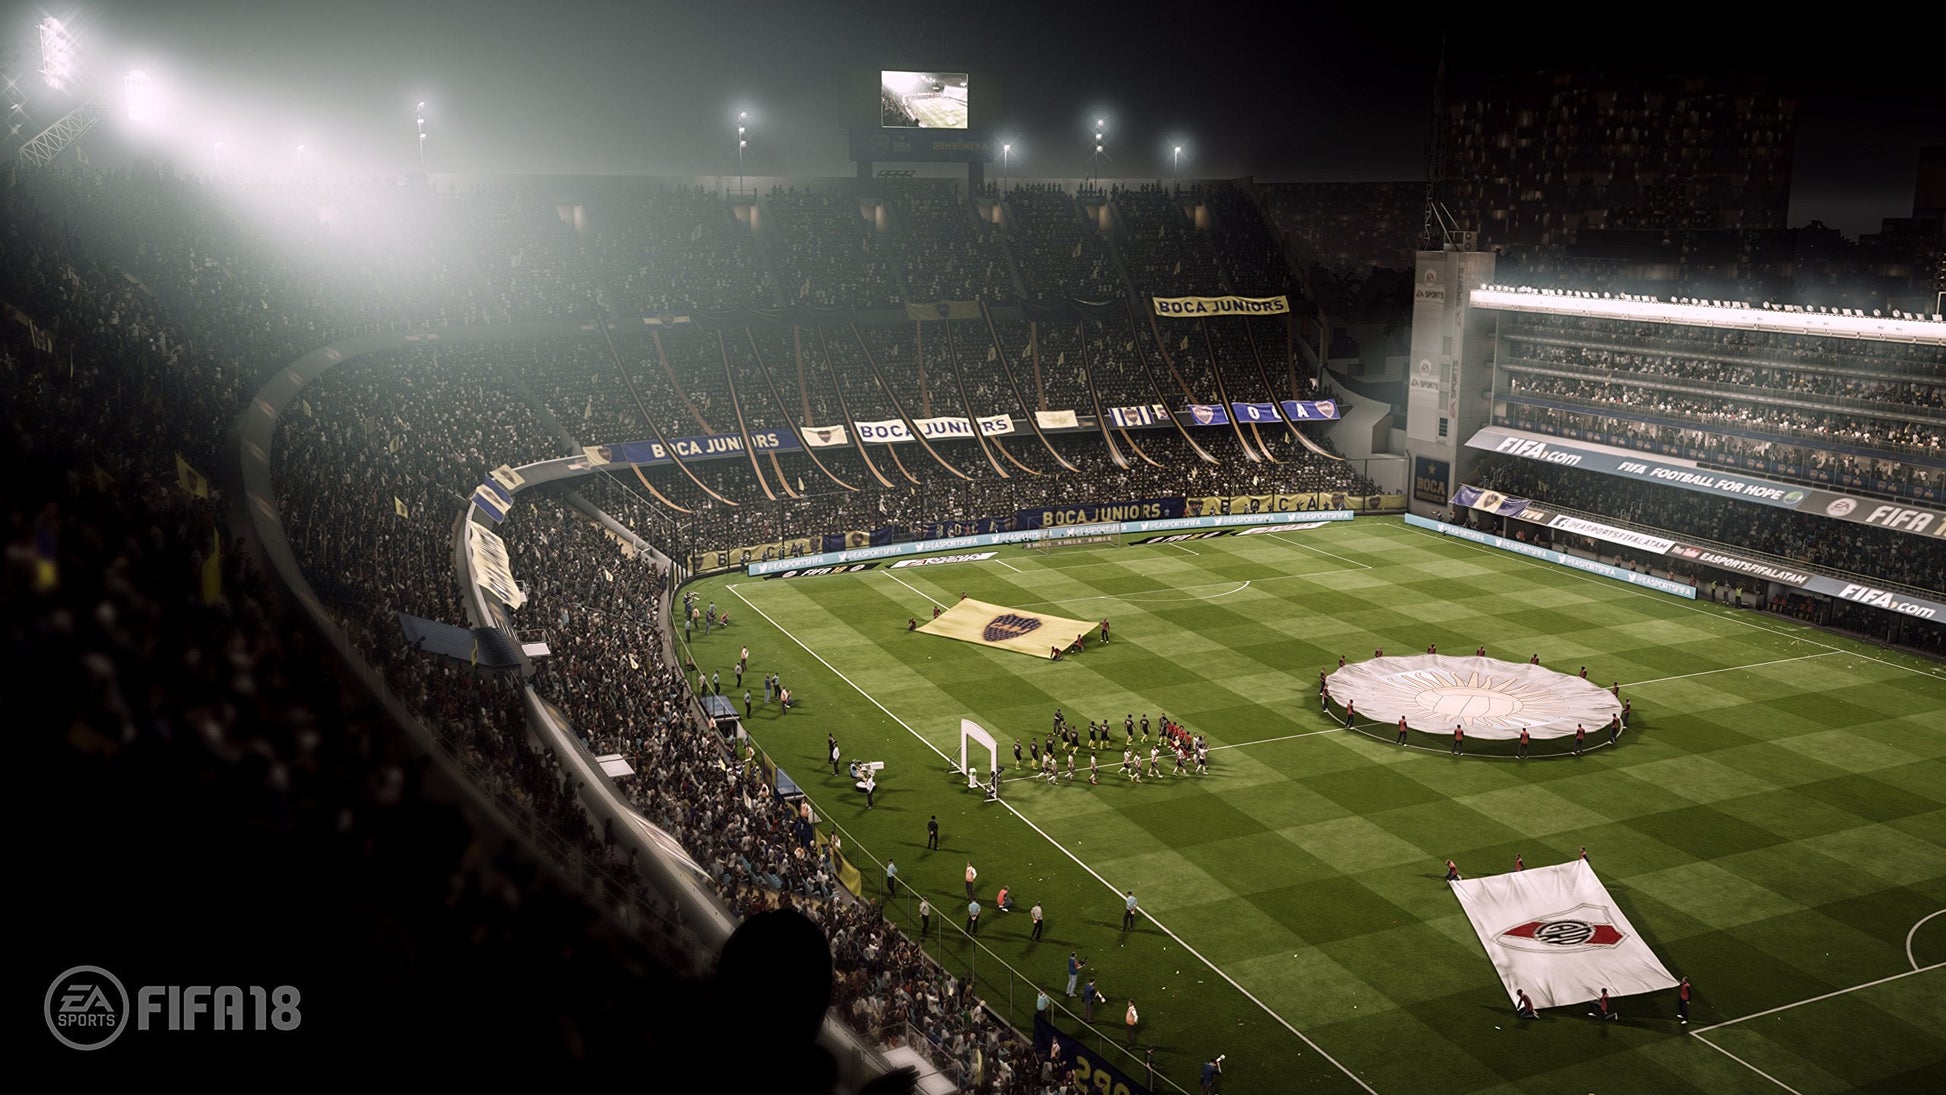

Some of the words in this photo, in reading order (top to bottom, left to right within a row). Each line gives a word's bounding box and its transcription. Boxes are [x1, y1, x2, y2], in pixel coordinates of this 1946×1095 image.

[1159, 301, 1208, 314] BOCA
[1211, 299, 1285, 313] JUNIORS
[924, 419, 1008, 435] JUNIRS
[1495, 436, 1582, 466] FIFA.com
[1416, 476, 1447, 496] BOCA
[1617, 461, 1648, 475] FIFA
[1650, 467, 1714, 487] FOOTBALL
[1714, 480, 1745, 493] FOR
[1744, 485, 1786, 500] HOPE
[1043, 509, 1087, 526] BOCA
[1092, 503, 1161, 522] JUNIORS
[1865, 505, 1935, 532] FIFA
[1699, 552, 1808, 584] EASPORTSFIFALATAM
[1838, 583, 1936, 618] FIFA.com
